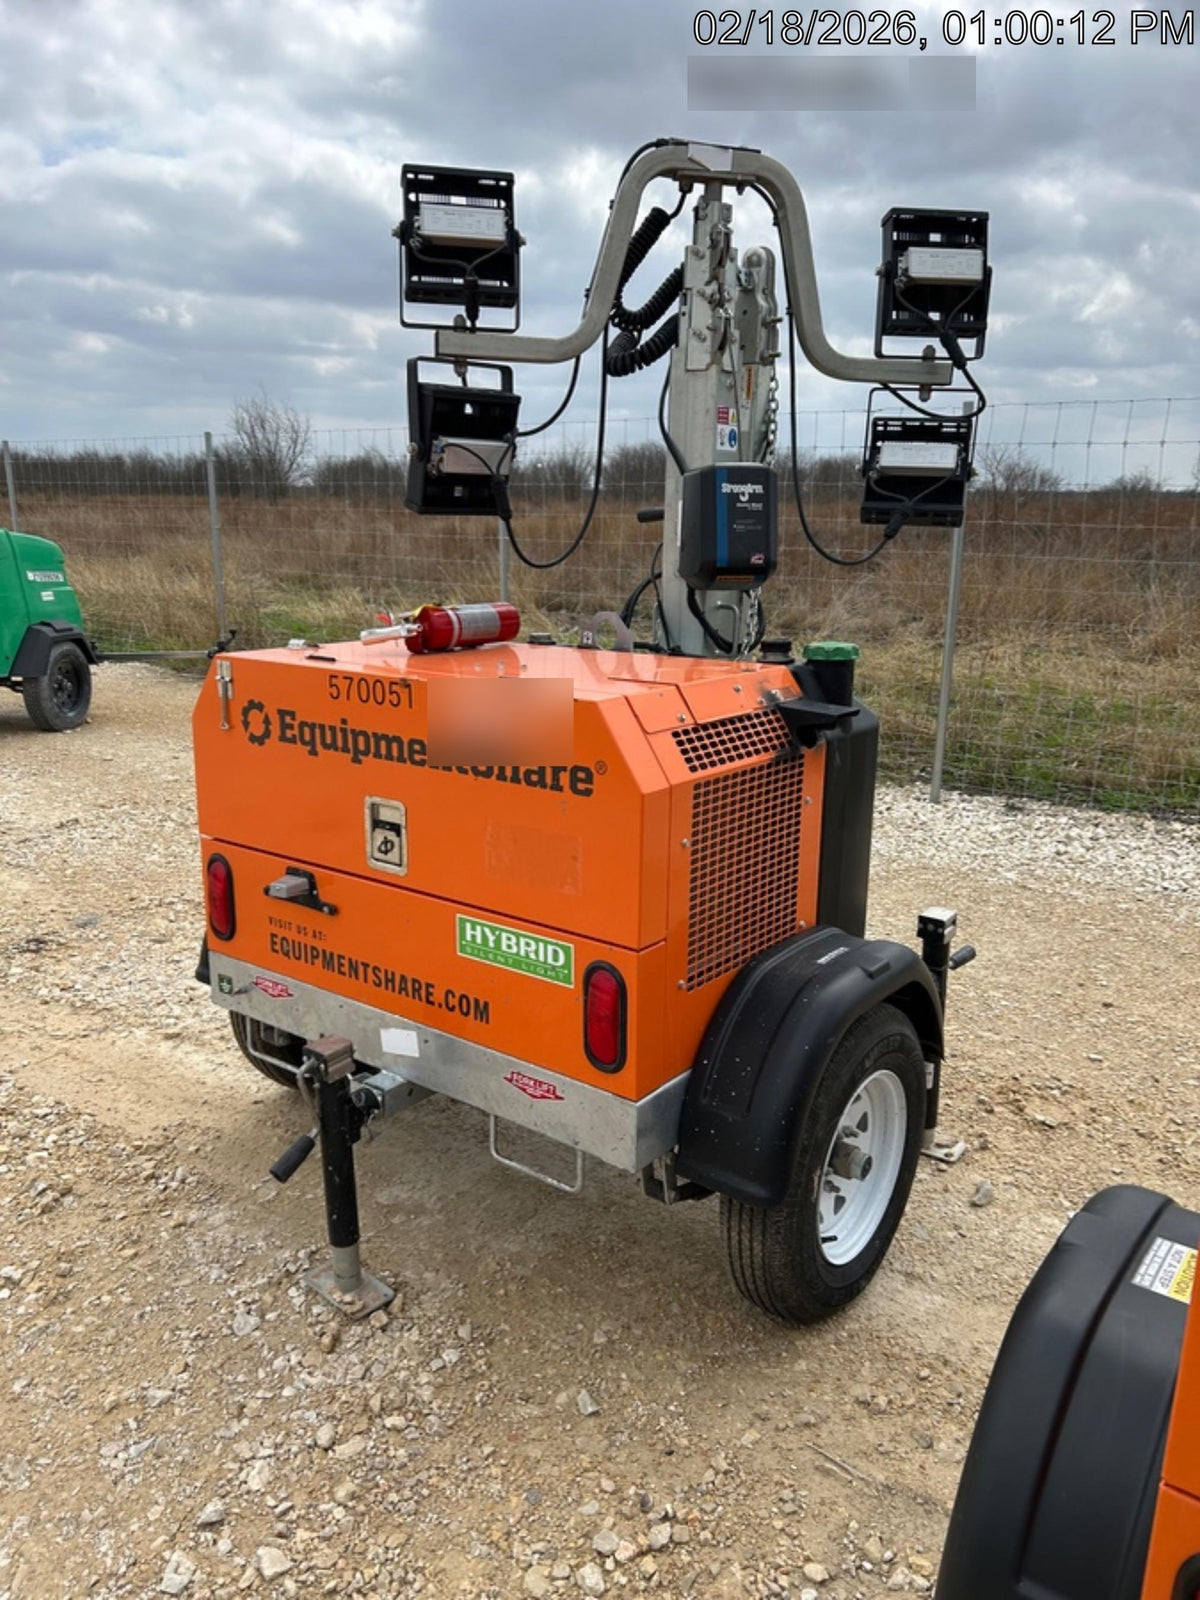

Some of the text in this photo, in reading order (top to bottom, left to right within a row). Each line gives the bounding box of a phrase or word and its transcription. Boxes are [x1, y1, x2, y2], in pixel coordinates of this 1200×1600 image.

[328, 674, 413, 709] 570051
[269, 916, 292, 931] VISIT
[296, 924, 308, 937] US
[465, 922, 566, 967] HYBRID
[270, 932, 490, 1025] EQUIPMENTSHARE.COM
[466, 946, 565, 979] SILENT LIGHT
